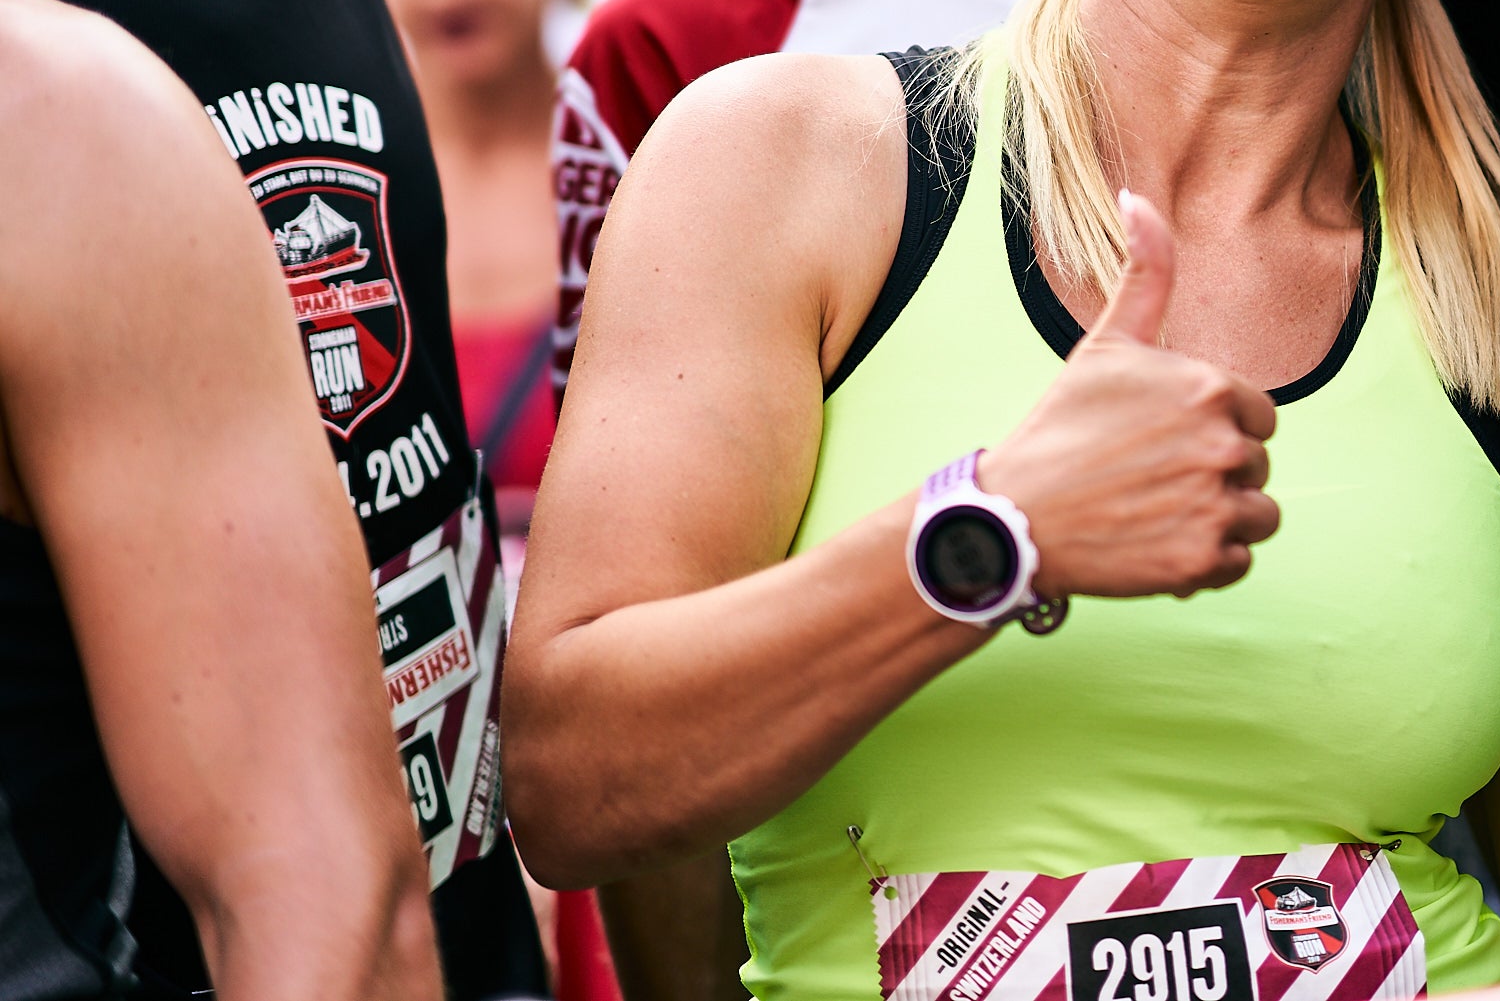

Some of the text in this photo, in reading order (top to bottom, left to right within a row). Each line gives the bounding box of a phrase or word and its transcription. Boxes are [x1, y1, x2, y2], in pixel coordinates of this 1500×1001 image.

[204, 81, 384, 160] iNiSHED
[293, 288, 340, 316] RMAN'S
[310, 343, 364, 398] RUN
[330, 393, 352, 413] 2011
[386, 627, 471, 712] FISHERM
[1308, 912, 1332, 922] FRIEND
[1092, 925, 1228, 1001] 2915
[1293, 938, 1327, 958] RUN
